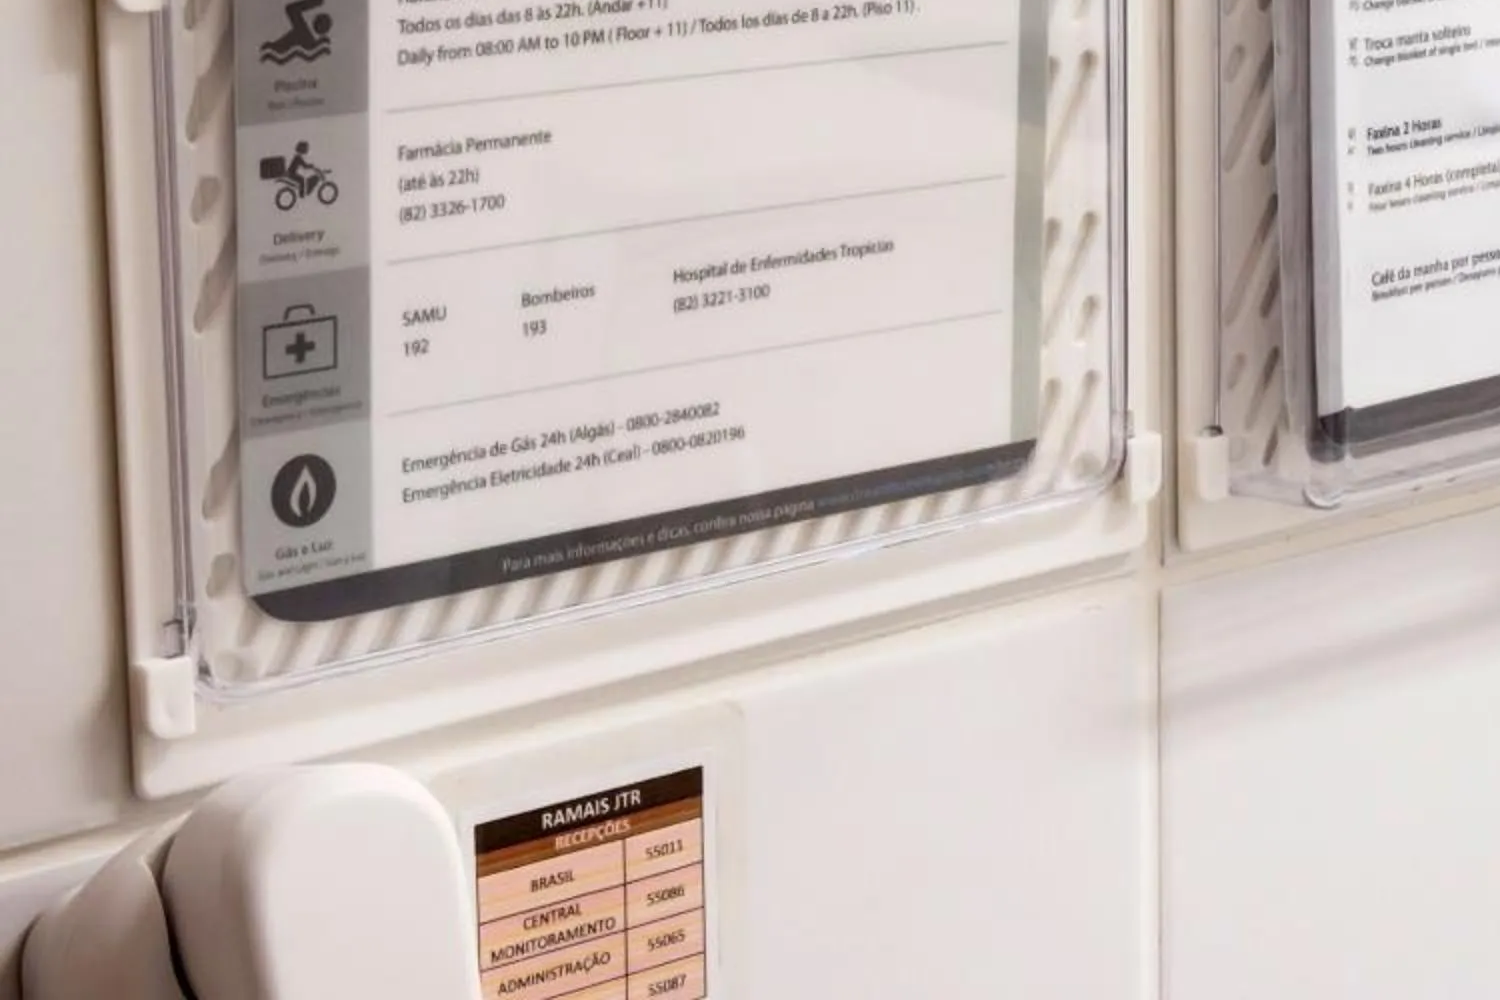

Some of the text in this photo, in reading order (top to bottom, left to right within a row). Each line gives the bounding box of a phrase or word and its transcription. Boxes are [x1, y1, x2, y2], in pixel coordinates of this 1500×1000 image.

[397, 17, 442, 34] Todos
[463, 11, 494, 29] dias
[495, 9, 521, 25] das
[555, 2, 585, 19] 22h.
[397, 29, 605, 66] Daily from 08:00 AM PM
[1365, 37, 1392, 51] Troca
[1396, 32, 1429, 46] manta
[1367, 124, 1400, 141] Faxina
[1412, 118, 1442, 132] Horas
[397, 130, 552, 161] Farmácia Permanente
[398, 168, 480, 194] (até 22h)
[399, 194, 506, 225] (82) 3326-1700
[273, 229, 326, 246] Delivery
[673, 262, 731, 284] Hospital
[730, 259, 748, 275] de
[1371, 271, 1395, 288] Café
[1398, 266, 1411, 280] da
[1451, 256, 1469, 270] por
[521, 285, 596, 308] Bombeiros
[673, 281, 771, 313] (82) 3221-3100
[402, 306, 447, 327] SAMU
[523, 319, 547, 336] 193
[404, 338, 429, 357] 192
[402, 448, 485, 474] Emergência
[489, 443, 507, 460] de
[511, 433, 536, 454] Gás
[540, 429, 567, 449] 24h
[626, 402, 720, 432] 0800-2840082
[402, 426, 744, 503] Emergência Eletricidade 24h (Ceal) 0800-0820196
[275, 543, 298, 560] Gás
[542, 789, 641, 830] RAMAIS JTR
[556, 819, 631, 850] RECEPÇÕES
[645, 839, 683, 858] 55011
[530, 869, 575, 892] BRASIL
[647, 886, 685, 906] 55086
[523, 903, 581, 929] CENTRAL
[491, 916, 616, 963] MONITORAMENTO
[648, 929, 685, 951] 55065
[498, 951, 611, 995] ADMINISTRAÇÃO
[649, 974, 686, 996] 55087
